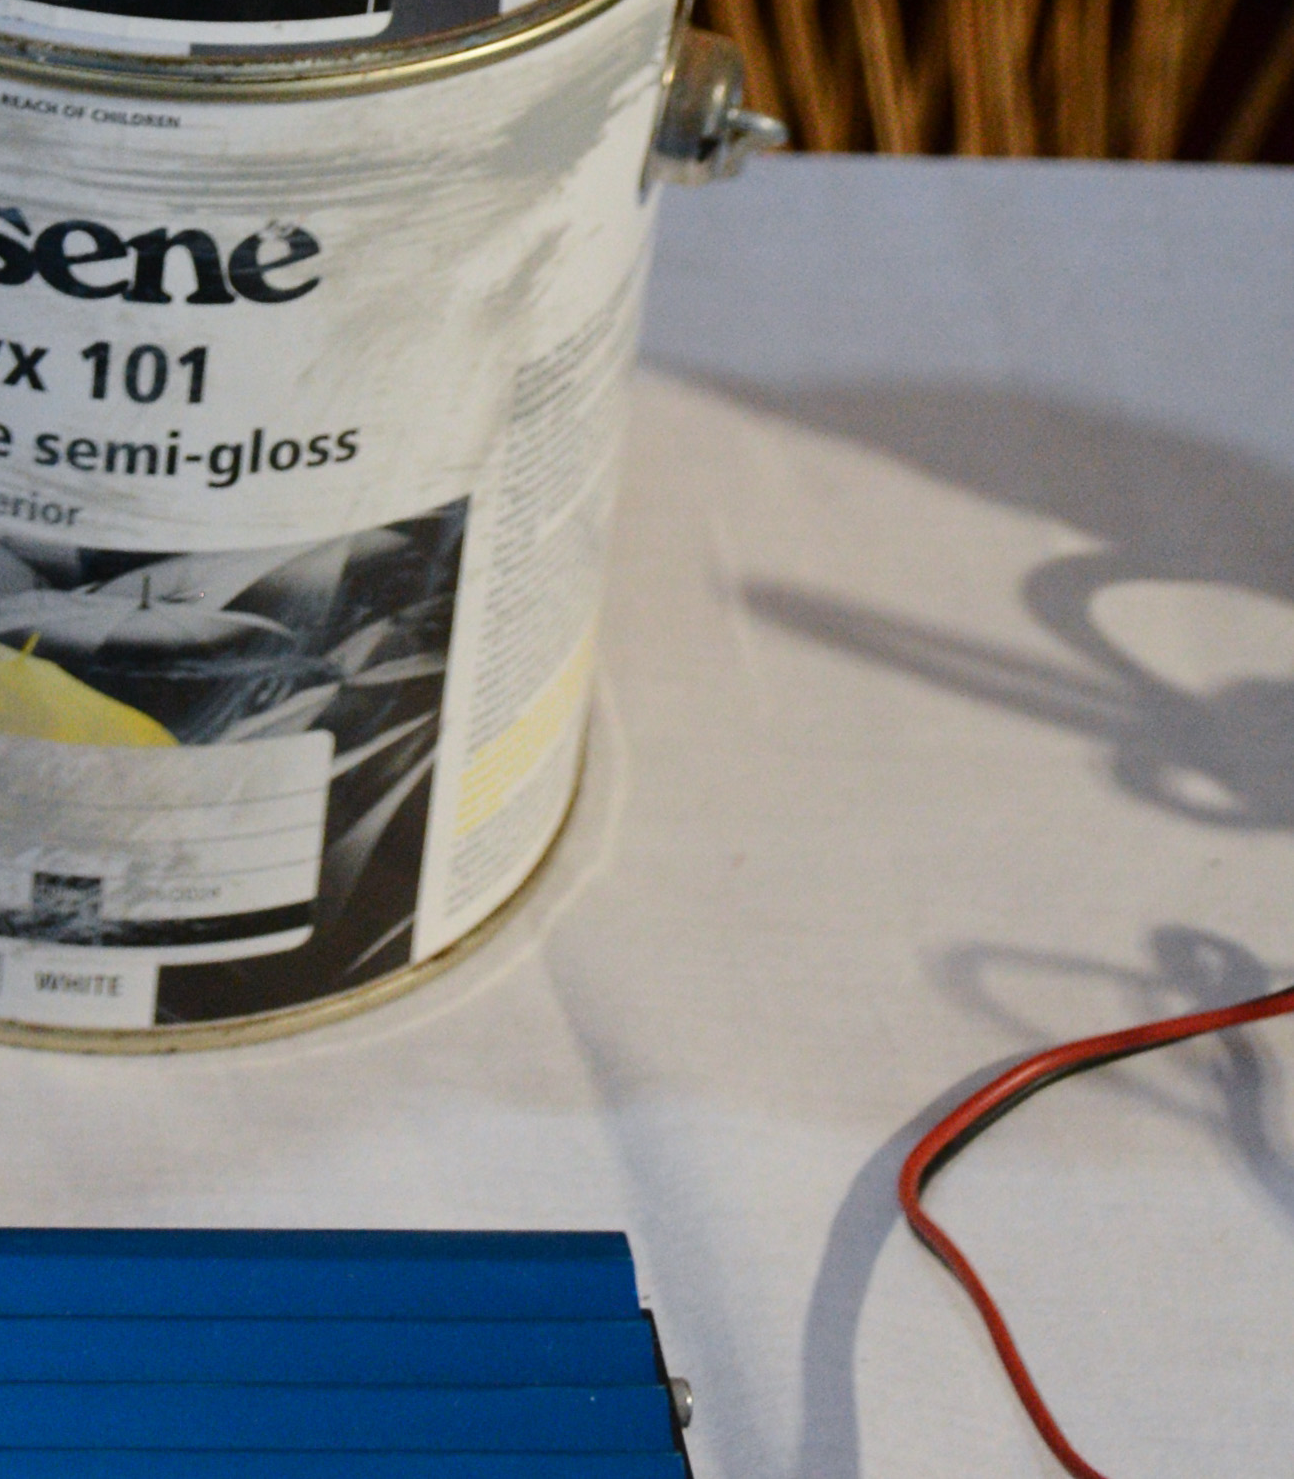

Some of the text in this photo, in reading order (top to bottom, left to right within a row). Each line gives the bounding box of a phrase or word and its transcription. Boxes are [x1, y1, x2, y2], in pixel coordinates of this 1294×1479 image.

[0, 91, 60, 118] REACH
[64, 103, 86, 121] OF
[91, 107, 181, 131] CHILDREN
[80, 341, 211, 405] 101
[34, 426, 362, 490] semi-gloss
[34, 969, 123, 1000] WHITE
